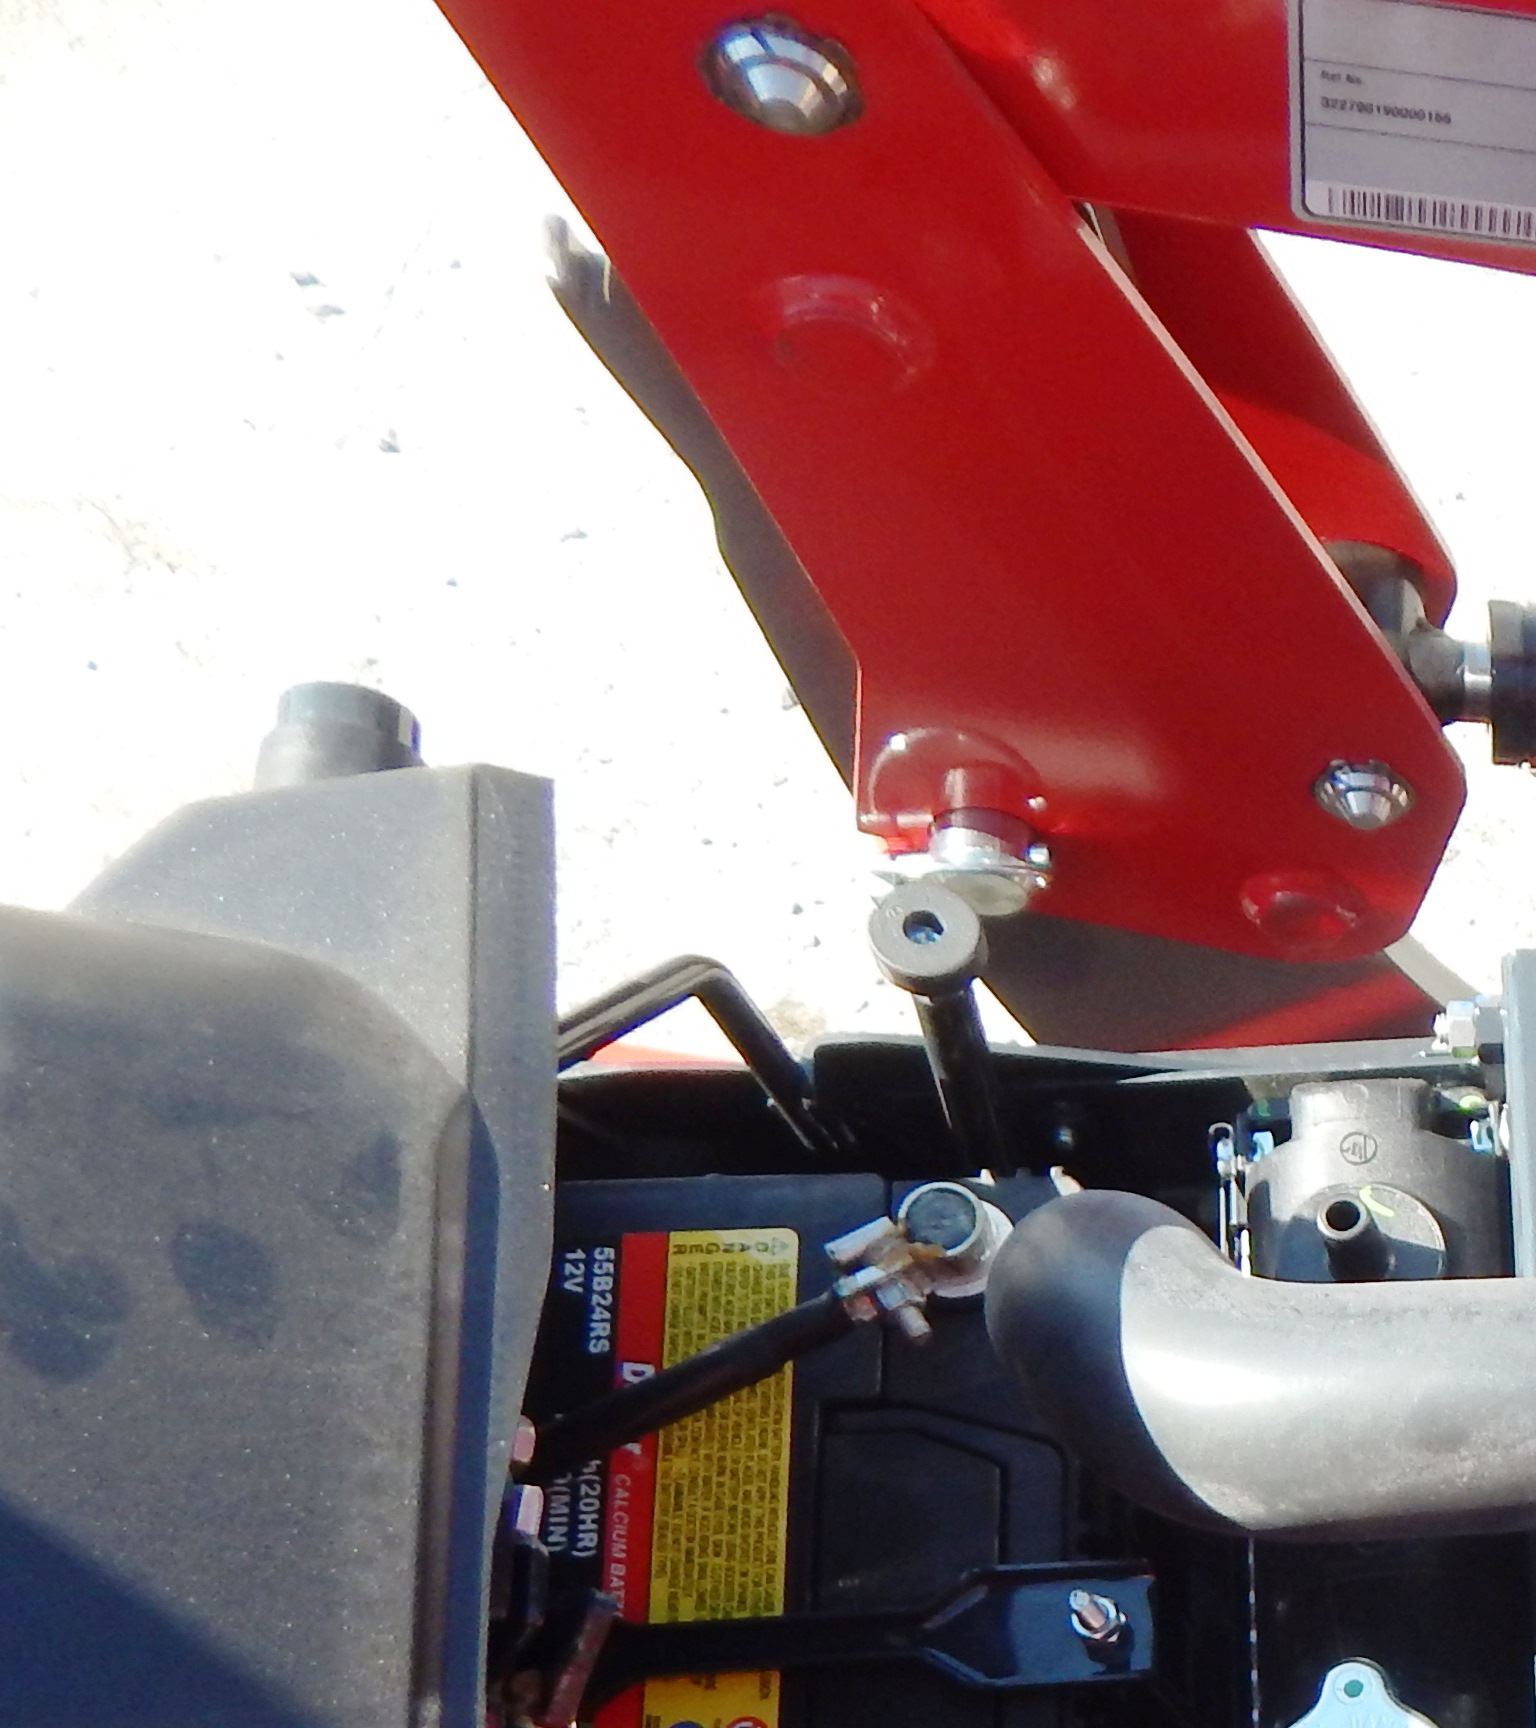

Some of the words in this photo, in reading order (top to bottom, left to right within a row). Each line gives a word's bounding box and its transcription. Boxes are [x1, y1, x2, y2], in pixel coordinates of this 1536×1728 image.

[563, 1248, 586, 1294] 12V
[672, 1241, 769, 1255] DANGER
[588, 1246, 615, 1354] 55B24RS
[610, 1473, 631, 1558] CALCIUM
